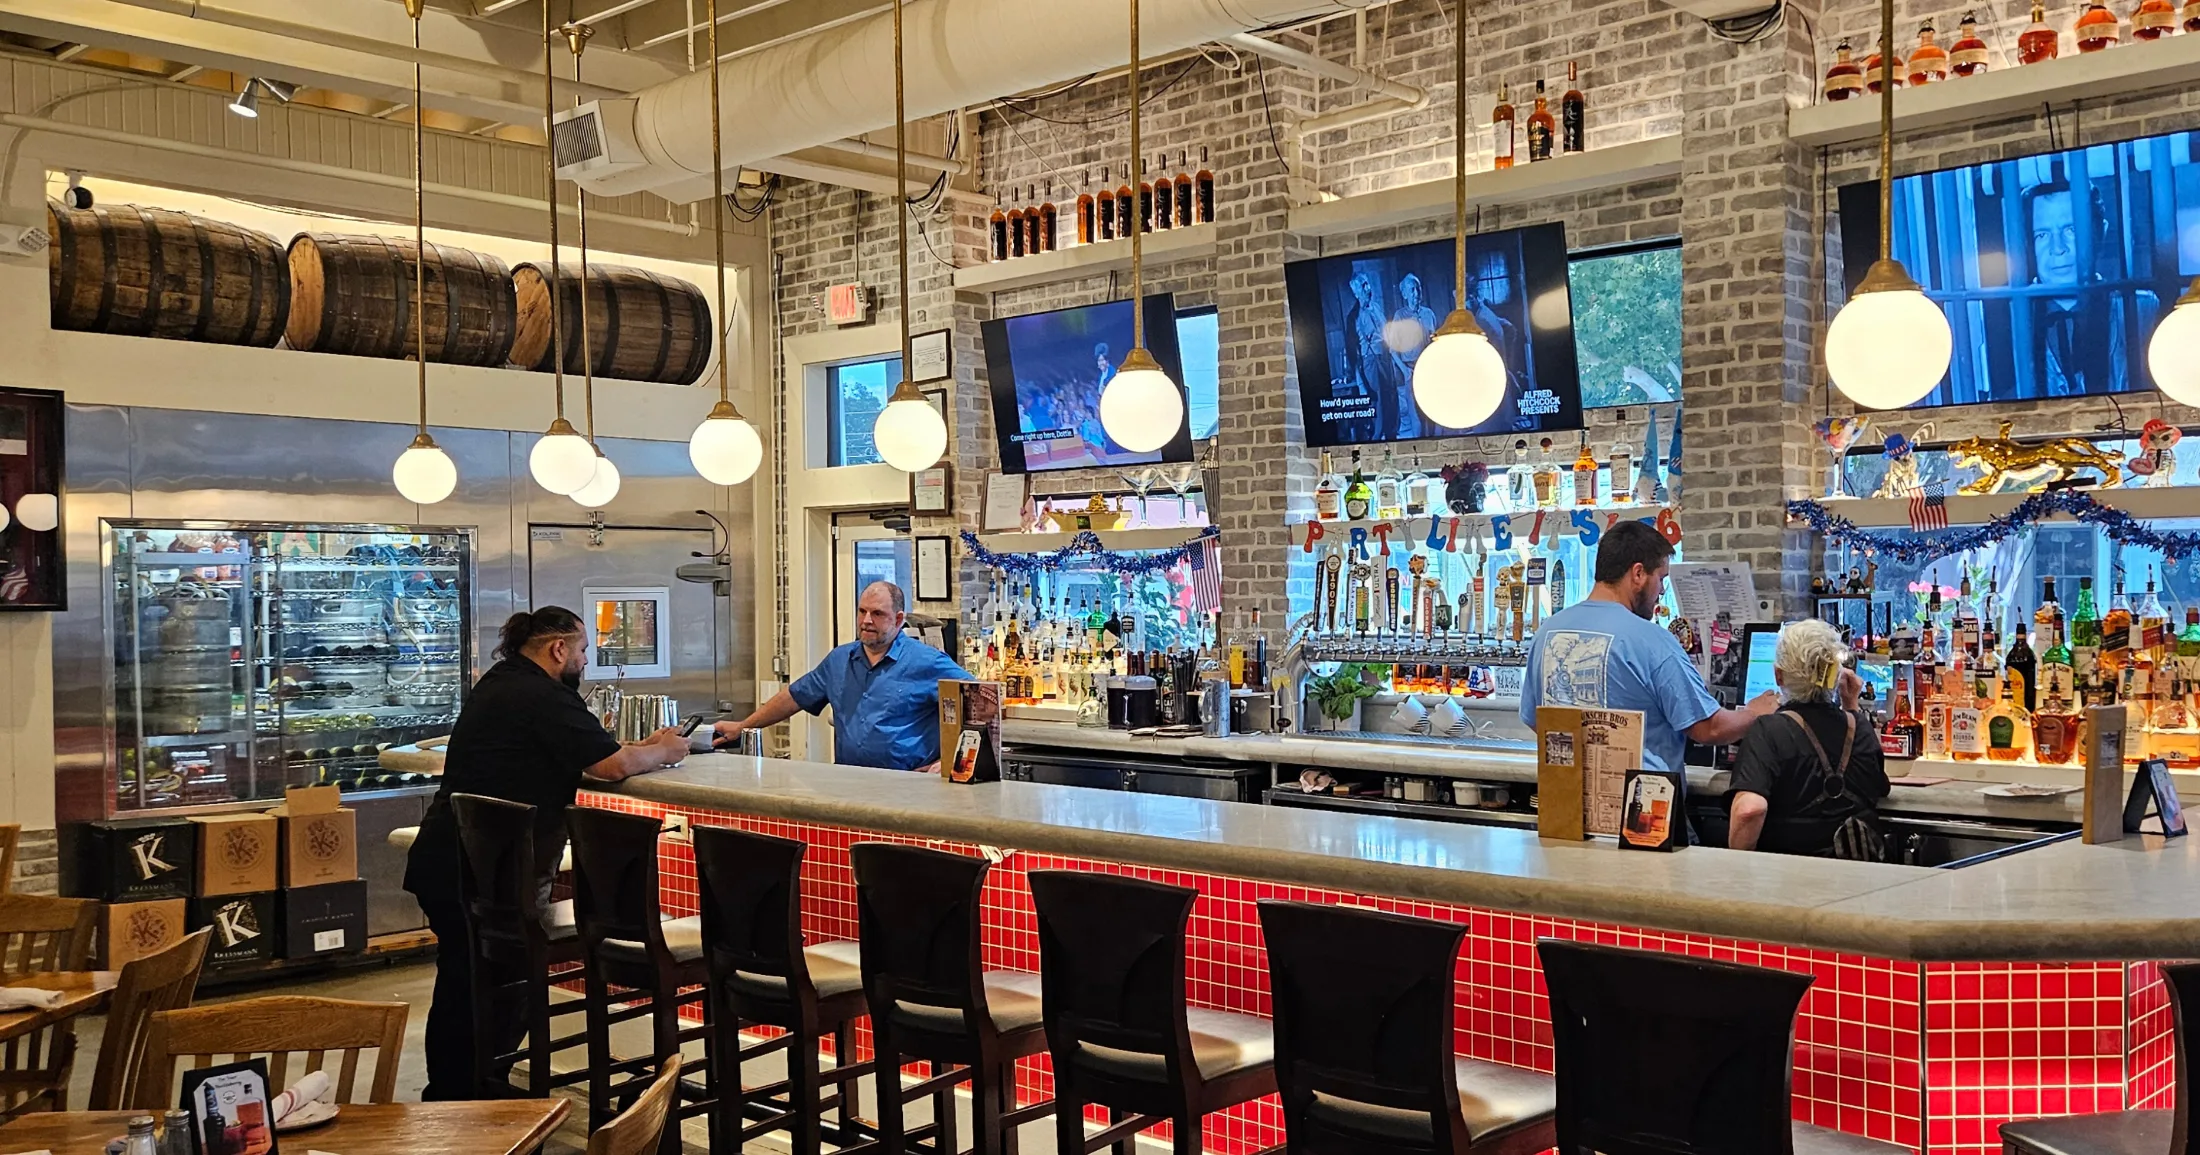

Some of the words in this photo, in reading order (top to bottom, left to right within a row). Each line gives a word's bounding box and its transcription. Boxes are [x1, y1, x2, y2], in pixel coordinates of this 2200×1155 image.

[1524, 389, 1552, 399] ALFRED
[1320, 398, 1341, 408] How'd
[1341, 399, 1354, 408] you
[1354, 397, 1370, 406] ever
[1518, 396, 1561, 408] HITCHCOCK
[1322, 411, 1334, 422] get
[1334, 411, 1343, 419] on
[1344, 410, 1355, 418] our
[1356, 408, 1376, 418] road?
[1520, 404, 1559, 415] PRESENTS
[1010, 434, 1024, 442] Come
[1025, 433, 1037, 442] right
[1426, 514, 1511, 554] LIKE
[1551, 580, 1560, 608] KONA
[1610, 711, 1628, 727] BROS
[1952, 713, 1961, 723] JIM
[1960, 712, 1977, 723] BEAM
[132, 836, 178, 880] K
[216, 904, 261, 948] K
[213, 947, 258, 959] KRESSMANN
